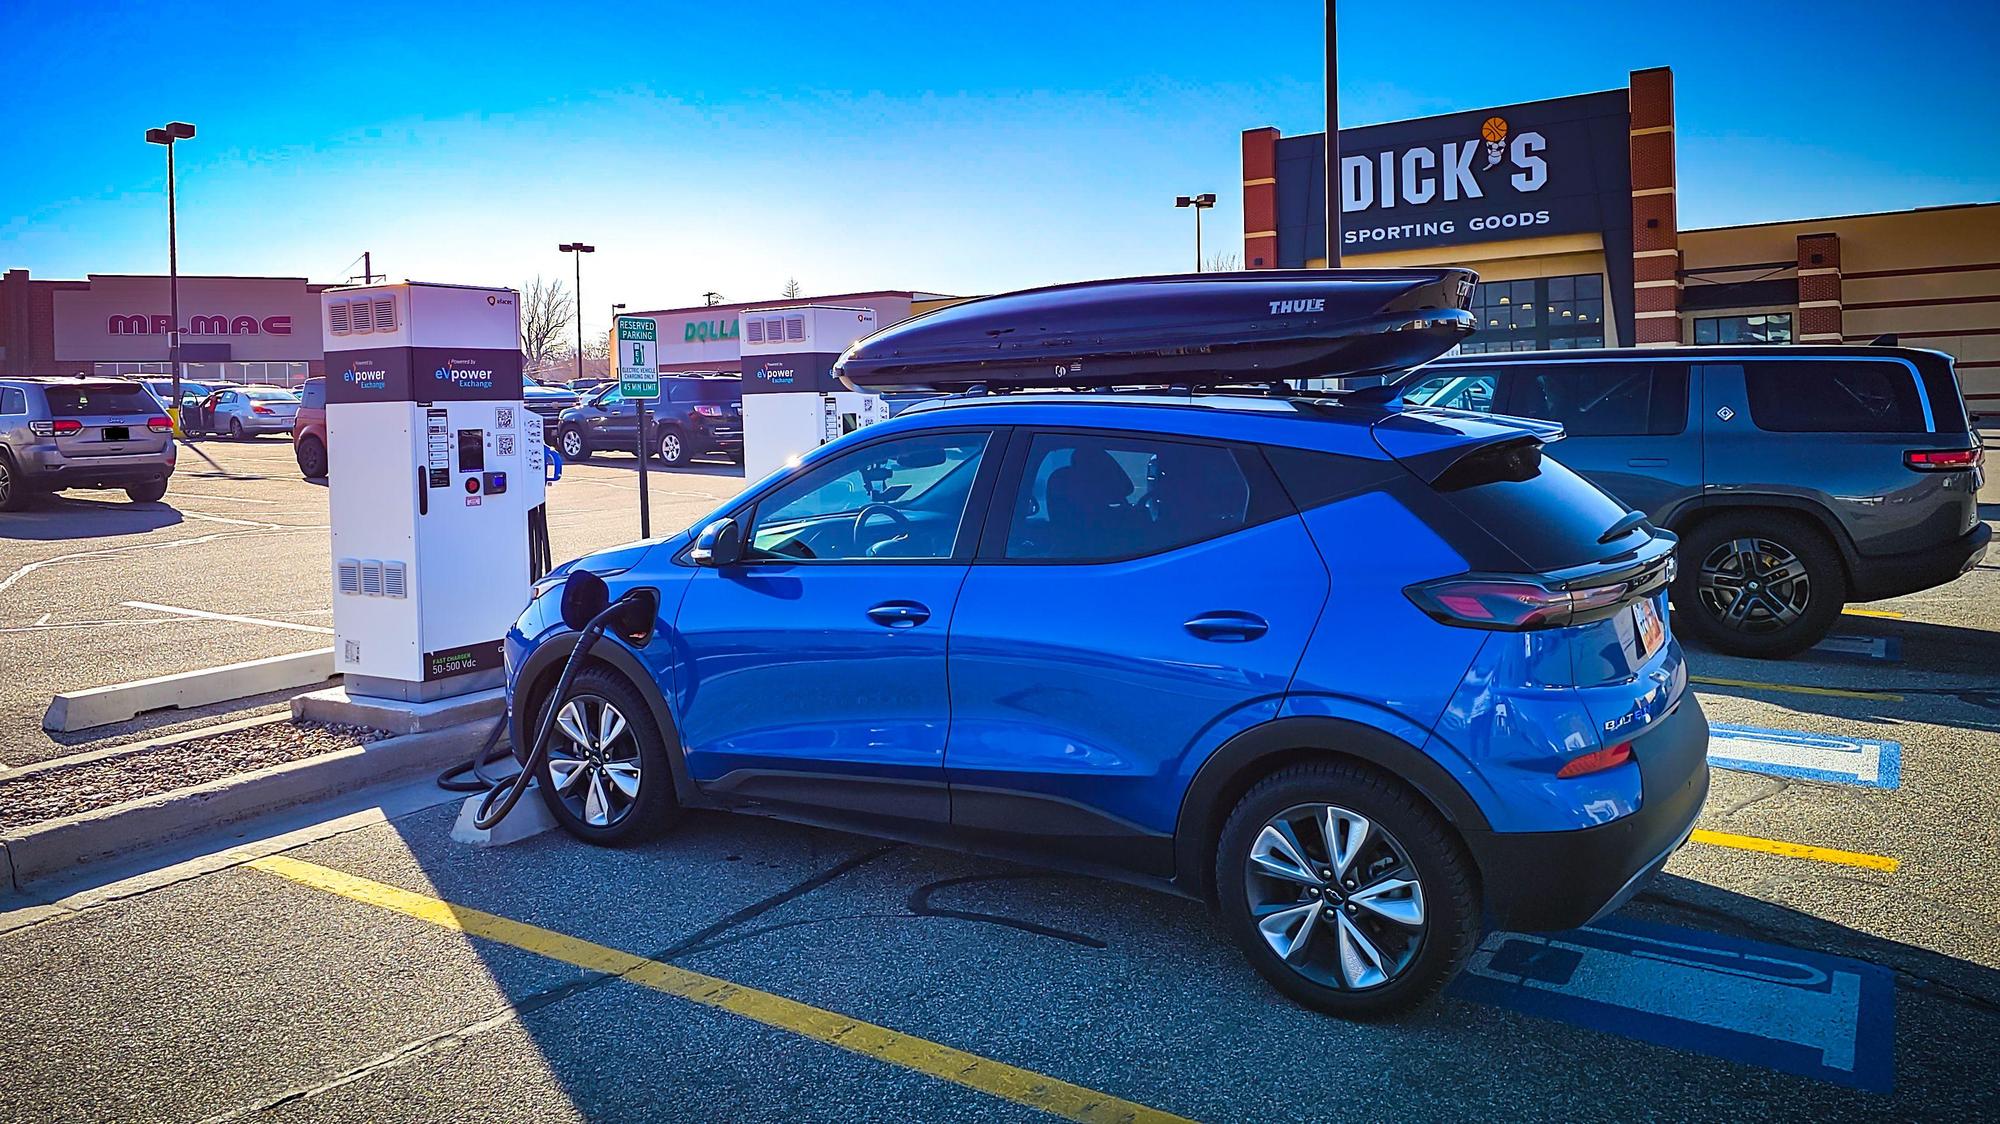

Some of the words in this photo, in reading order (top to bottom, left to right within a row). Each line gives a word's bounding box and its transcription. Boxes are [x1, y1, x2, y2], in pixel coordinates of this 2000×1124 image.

[1342, 131, 1548, 213] DICK'S
[1344, 220, 1455, 244] SPORTING
[1468, 210, 1550, 232] GOODS
[1270, 299, 1325, 314] THULE
[620, 321, 654, 330] RESERVED
[622, 331, 652, 339] PARKING
[460, 380, 492, 388] Exchange
[432, 657, 446, 666] FAST
[446, 652, 472, 662] CHARGER
[432, 661, 461, 675] 50-500
[461, 658, 477, 669] Vdc
